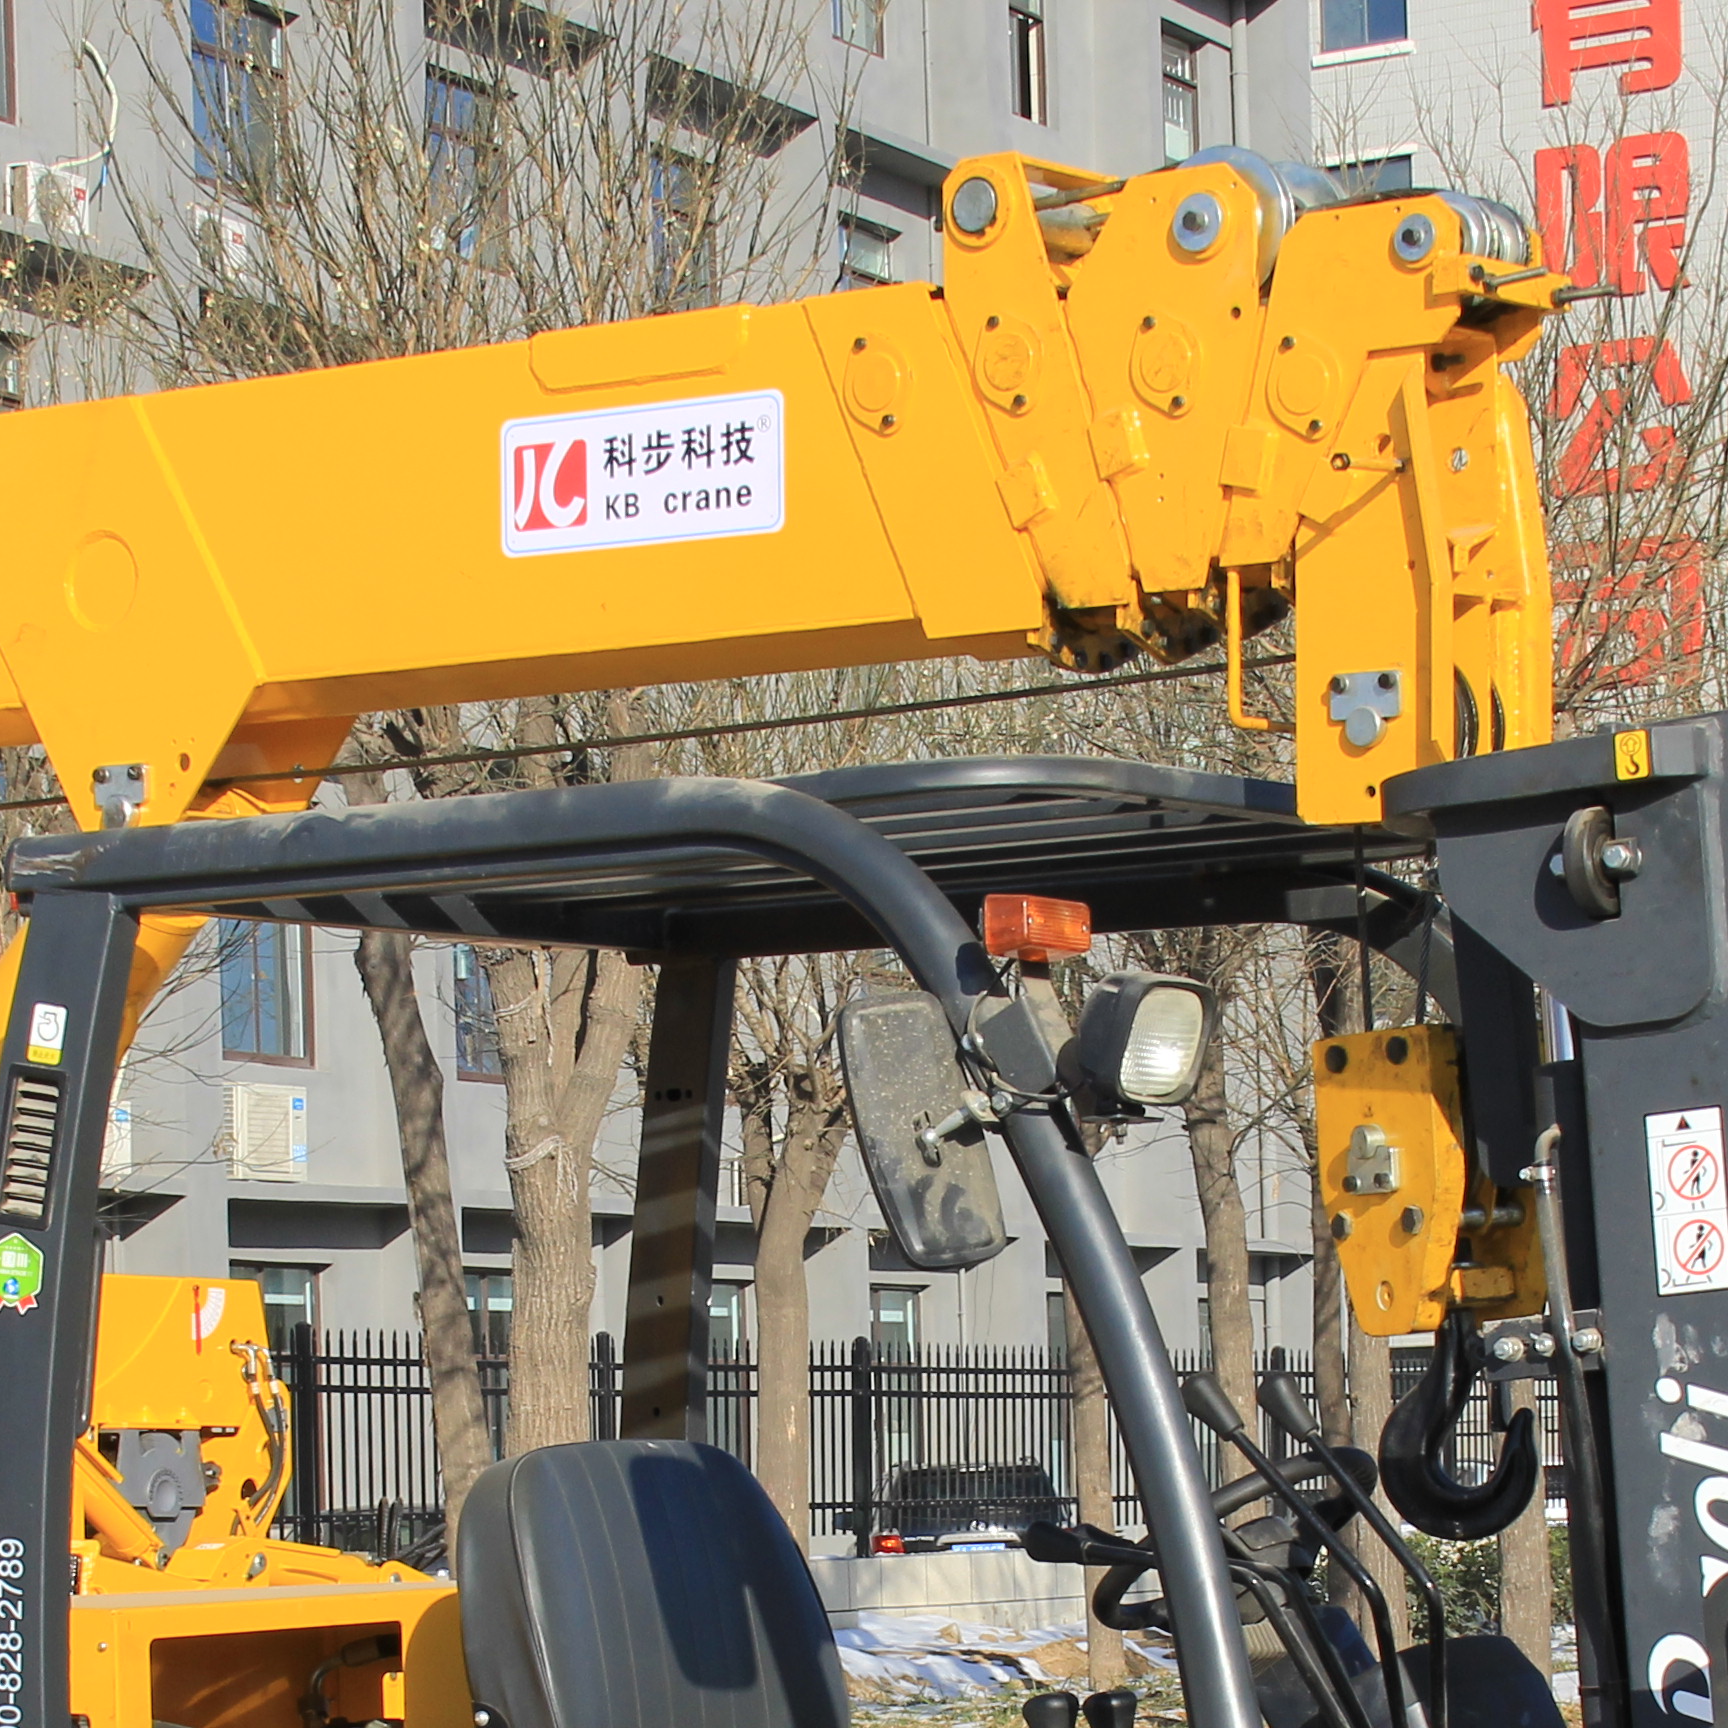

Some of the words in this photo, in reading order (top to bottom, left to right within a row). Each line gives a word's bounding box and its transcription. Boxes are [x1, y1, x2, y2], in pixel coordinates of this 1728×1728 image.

[603, 420, 756, 479] 科步科技
[605, 492, 641, 521] KB
[664, 484, 753, 514] crane
